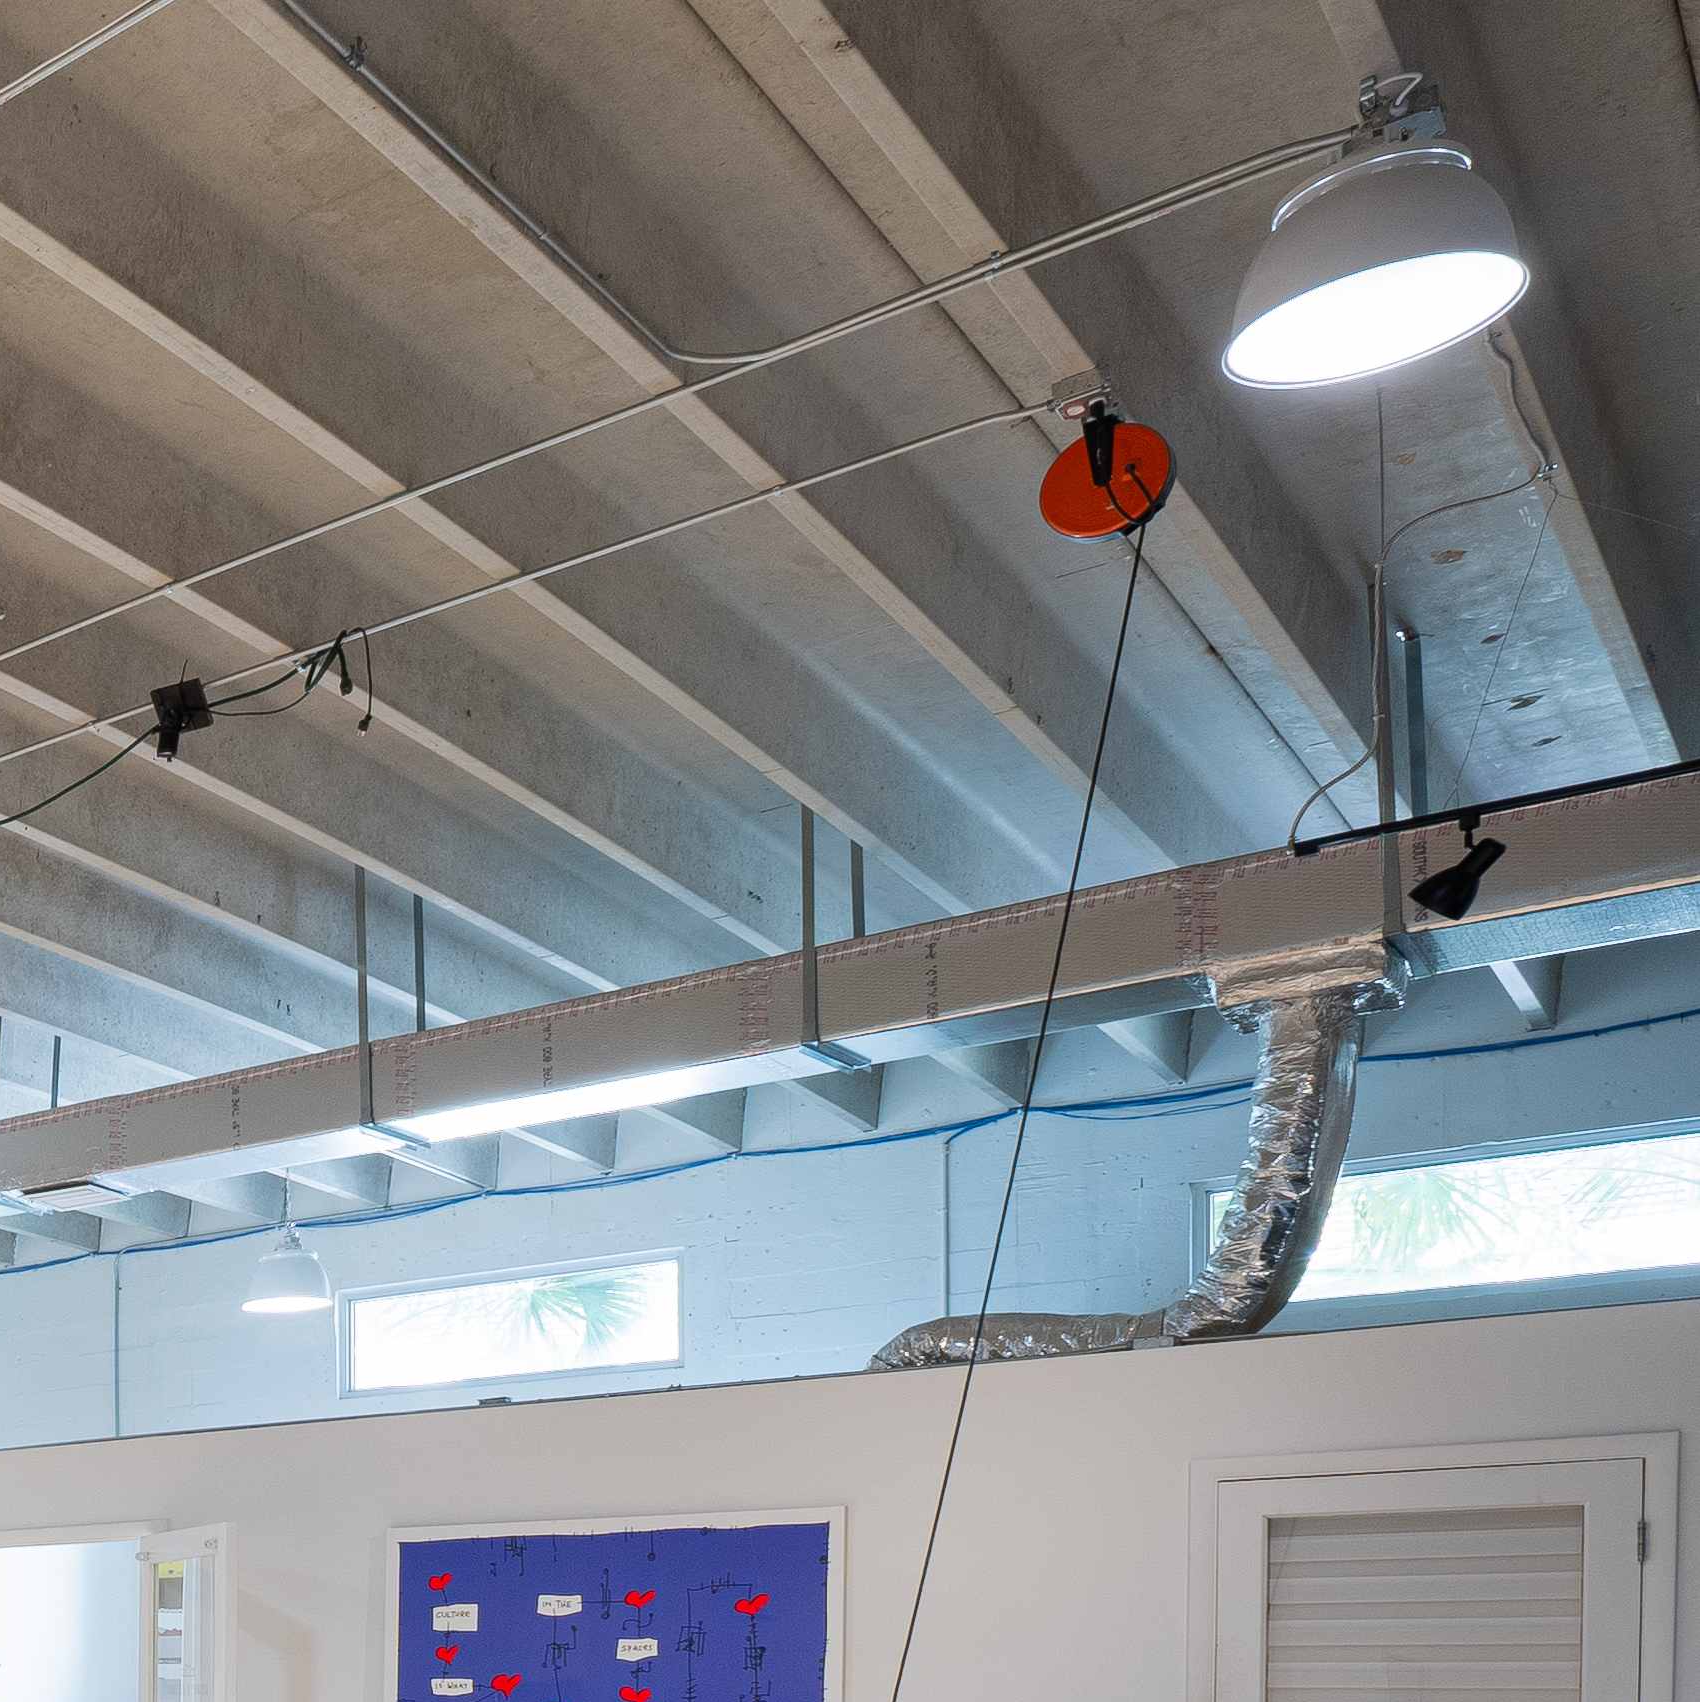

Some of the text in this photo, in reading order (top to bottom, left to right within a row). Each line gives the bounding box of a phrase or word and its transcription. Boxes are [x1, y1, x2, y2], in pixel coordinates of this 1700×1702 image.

[556, 1600, 571, 1609] THE
[435, 1610, 471, 1618] CULTURE
[621, 1644, 653, 1653] SPACES
